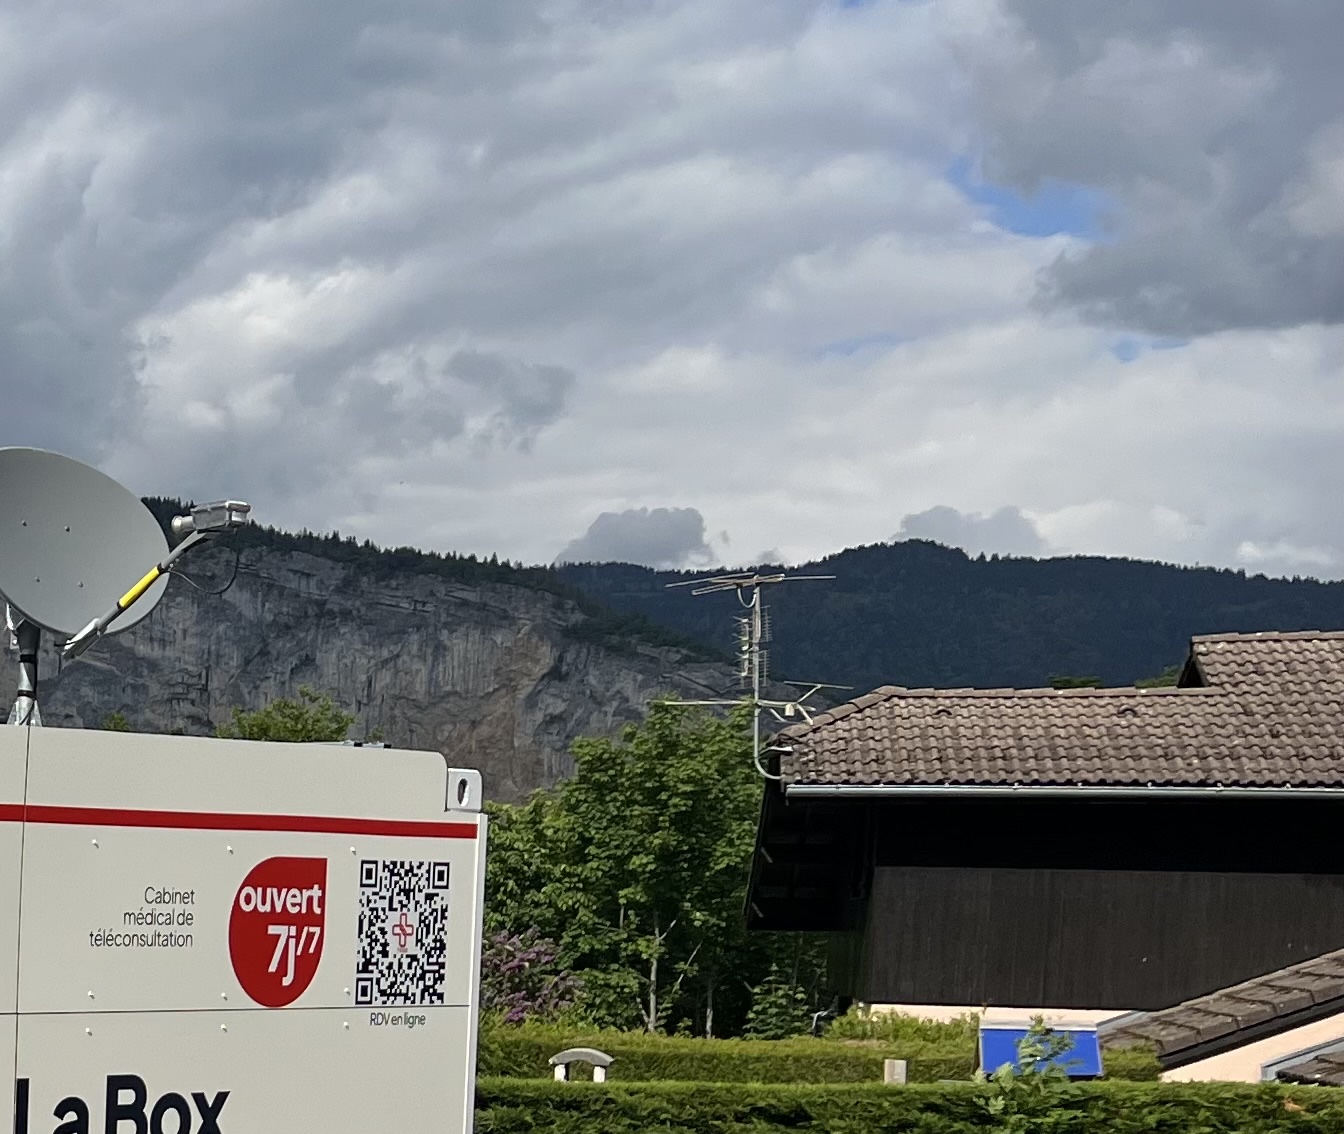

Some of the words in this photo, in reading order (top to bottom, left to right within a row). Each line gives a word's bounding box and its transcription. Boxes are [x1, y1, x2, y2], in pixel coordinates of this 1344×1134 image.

[144, 886, 195, 905] Cabinet
[239, 884, 322, 915] ouvert
[123, 906, 175, 926] médical
[177, 907, 194, 926] de
[89, 927, 194, 948] téléconsultation
[266, 924, 322, 987] 7j/7
[369, 1011, 391, 1026] RDV
[391, 1015, 403, 1026] en
[404, 1011, 426, 1029] ligne
